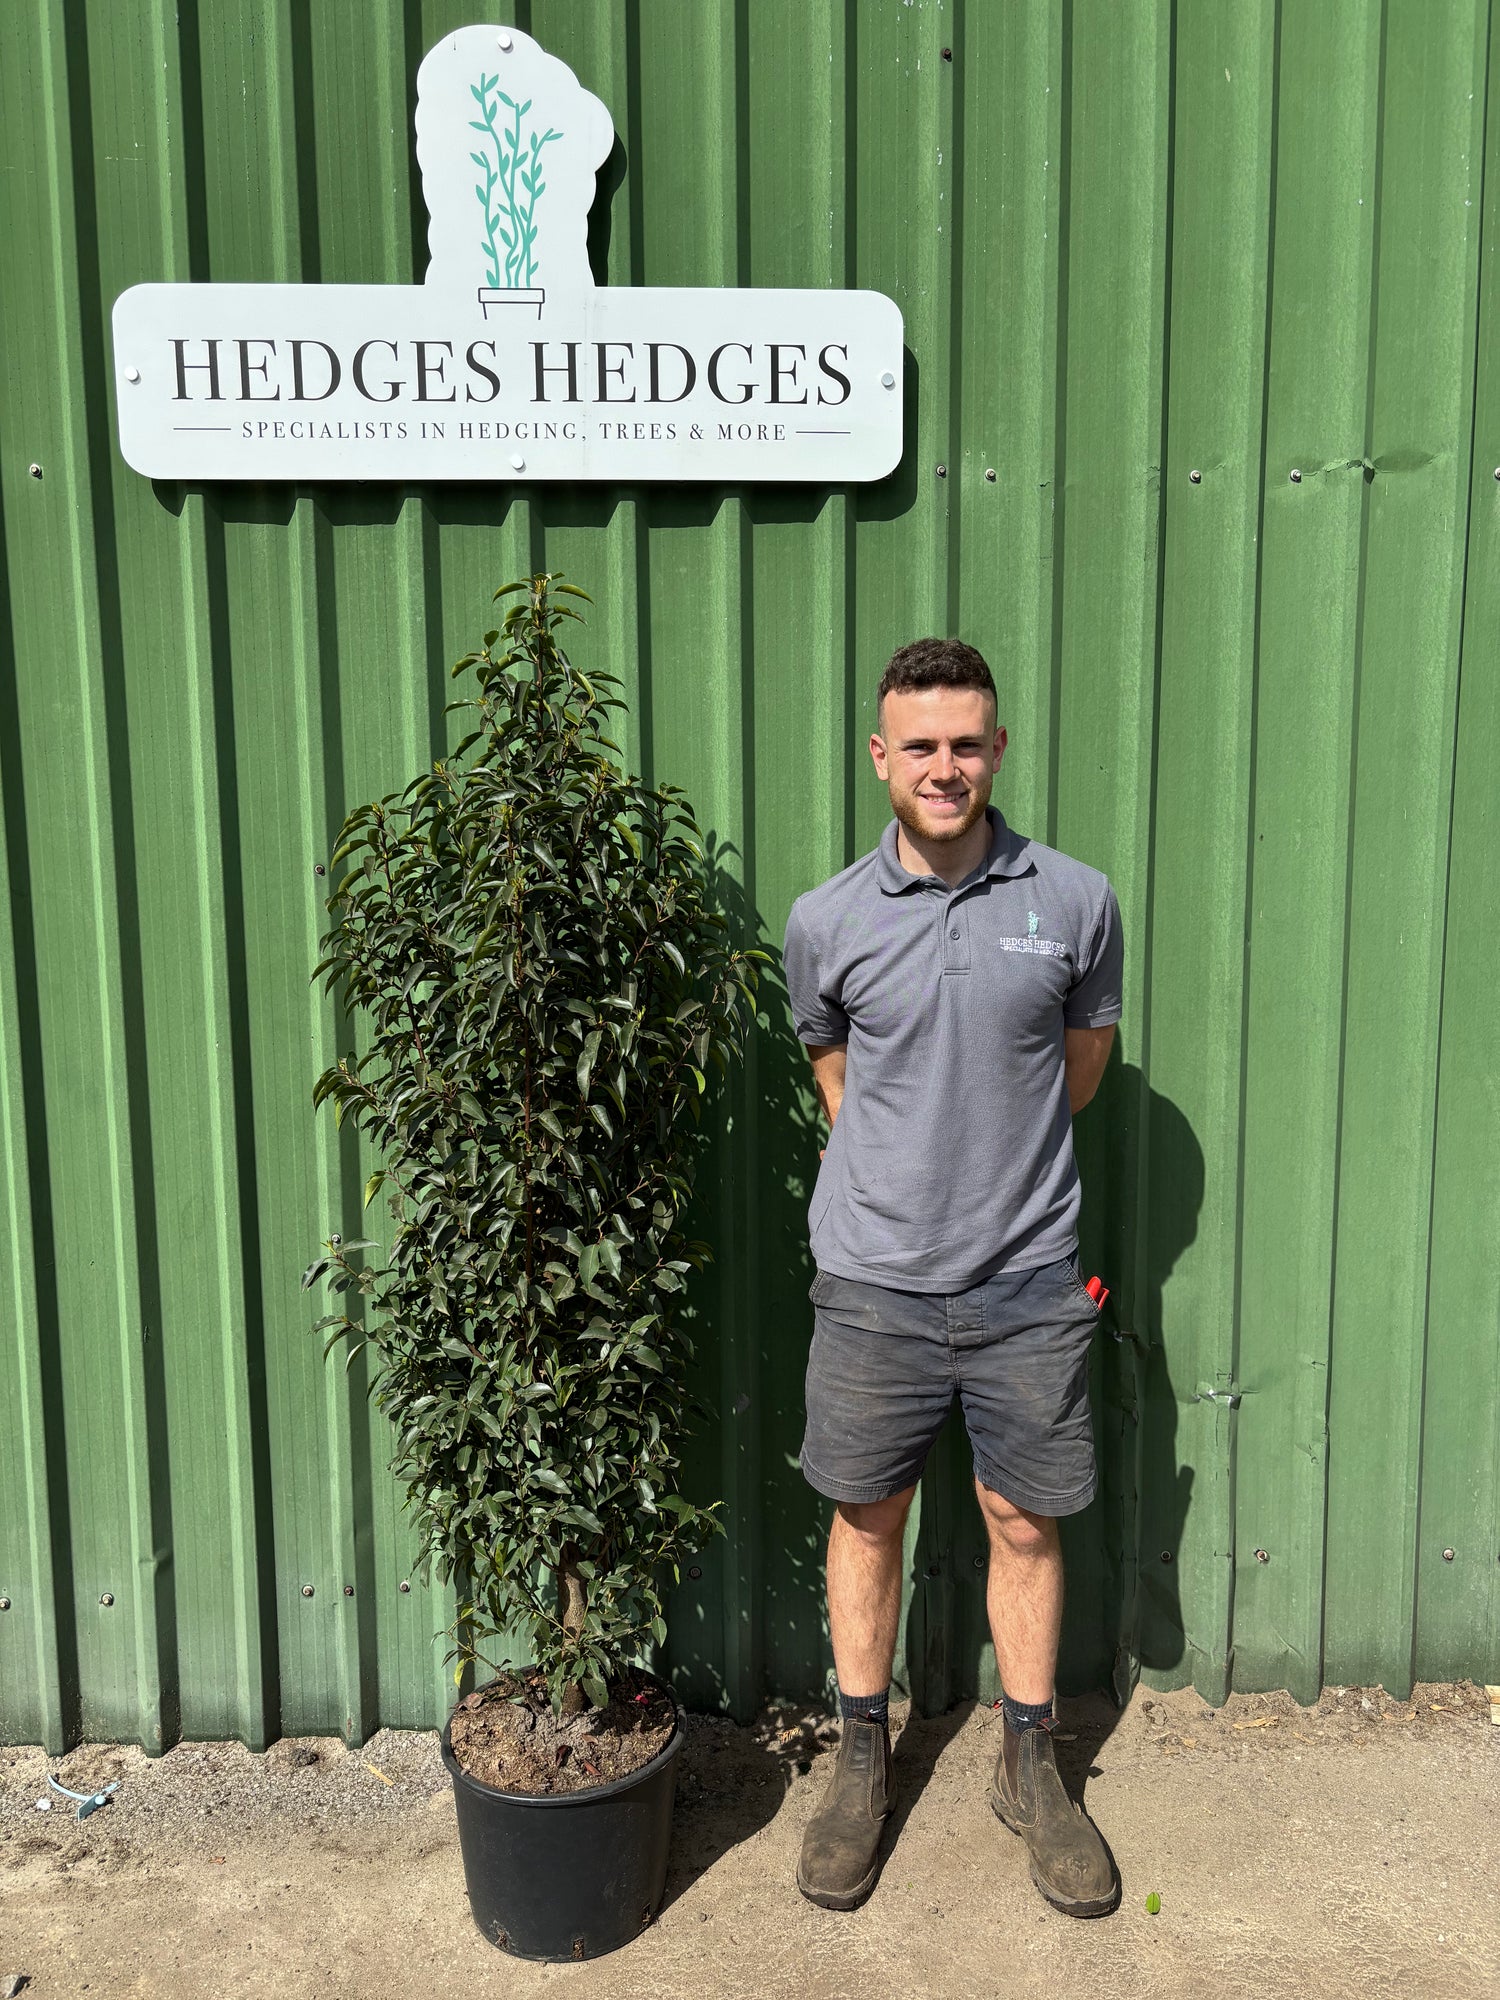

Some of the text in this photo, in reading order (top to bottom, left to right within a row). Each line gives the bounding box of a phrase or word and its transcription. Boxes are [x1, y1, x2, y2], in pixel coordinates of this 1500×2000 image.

[168, 339, 852, 406] HEDGES HEDGES
[242, 421, 786, 441] SPECIALISTS IN HEDGING, TREES & MORE
[1000, 937, 1066, 952] HEDGES HEDGES
